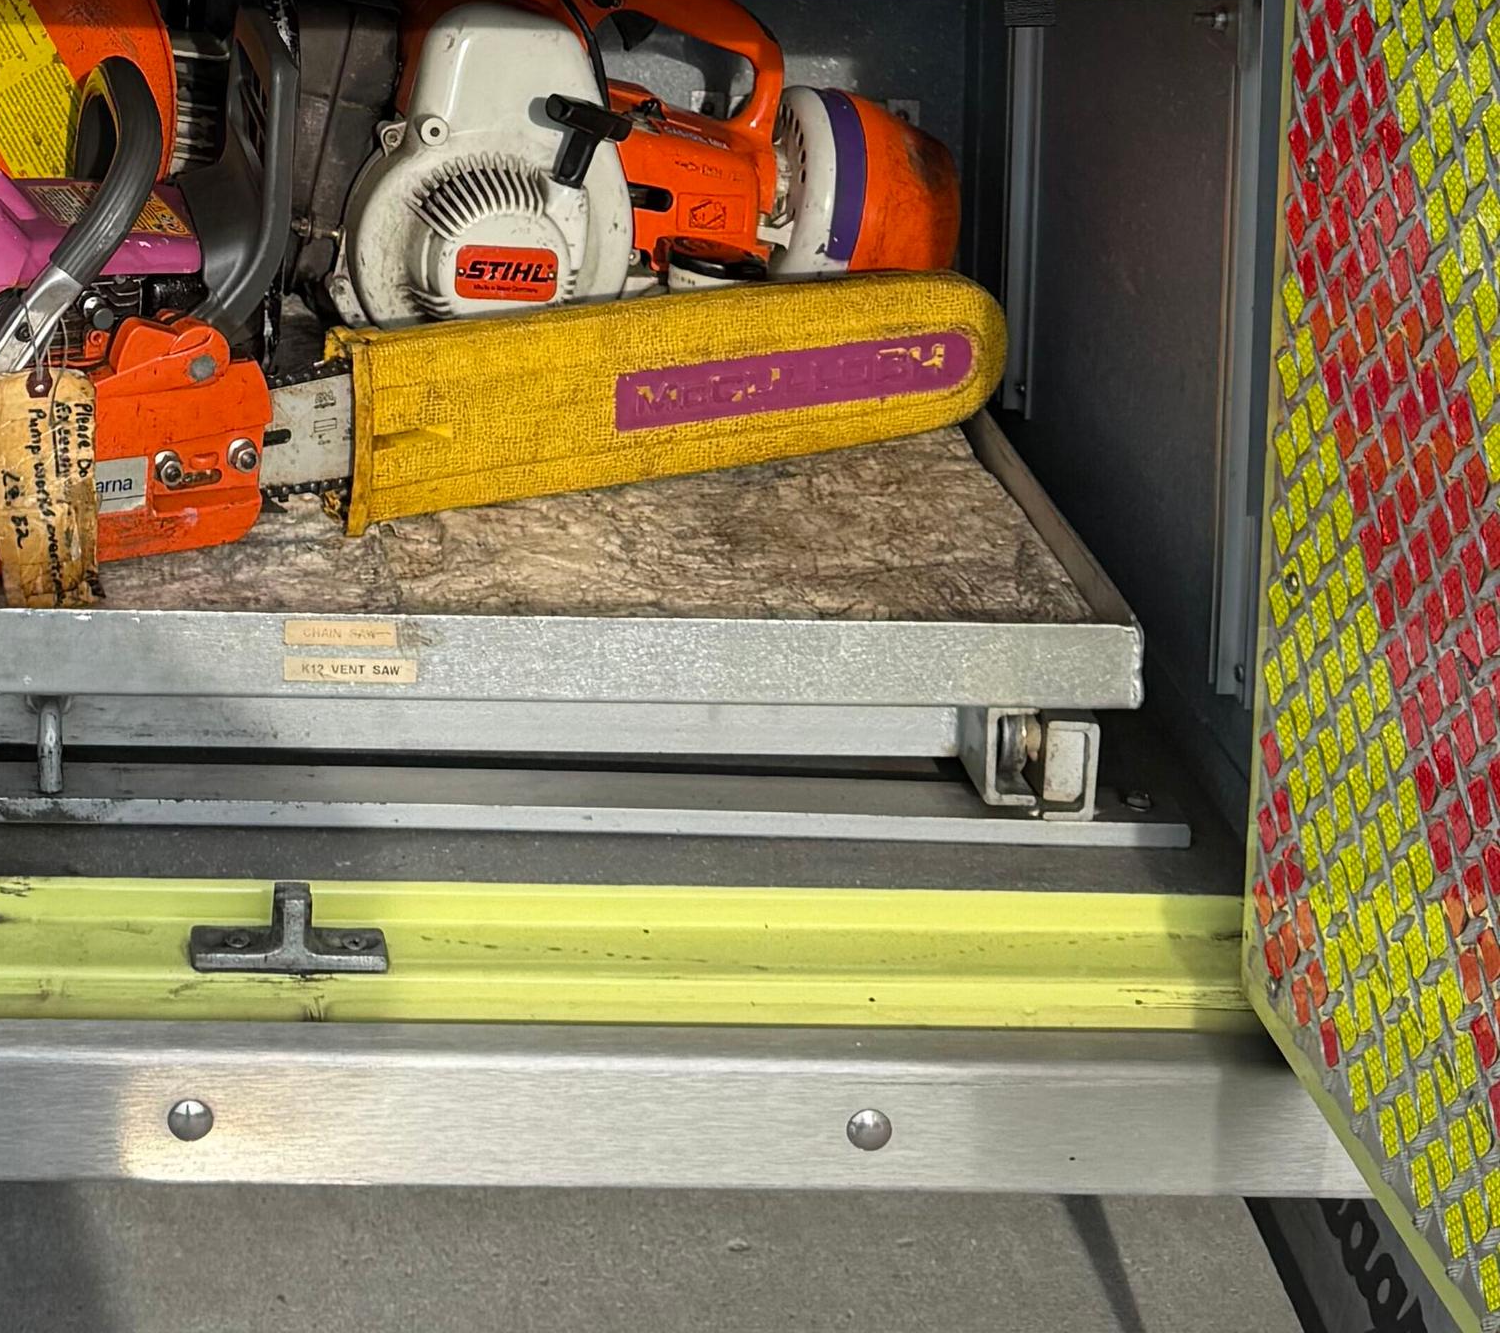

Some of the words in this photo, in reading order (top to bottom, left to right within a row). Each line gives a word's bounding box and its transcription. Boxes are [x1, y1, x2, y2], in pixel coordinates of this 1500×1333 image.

[465, 260, 549, 284] STIHL
[25, 408, 47, 455] Pump
[75, 402, 94, 449] Please
[76, 458, 93, 479] Do
[302, 628, 342, 639] CHAIN
[301, 664, 324, 675] K12
[330, 664, 366, 675] VENT
[372, 664, 401, 676] SAW
